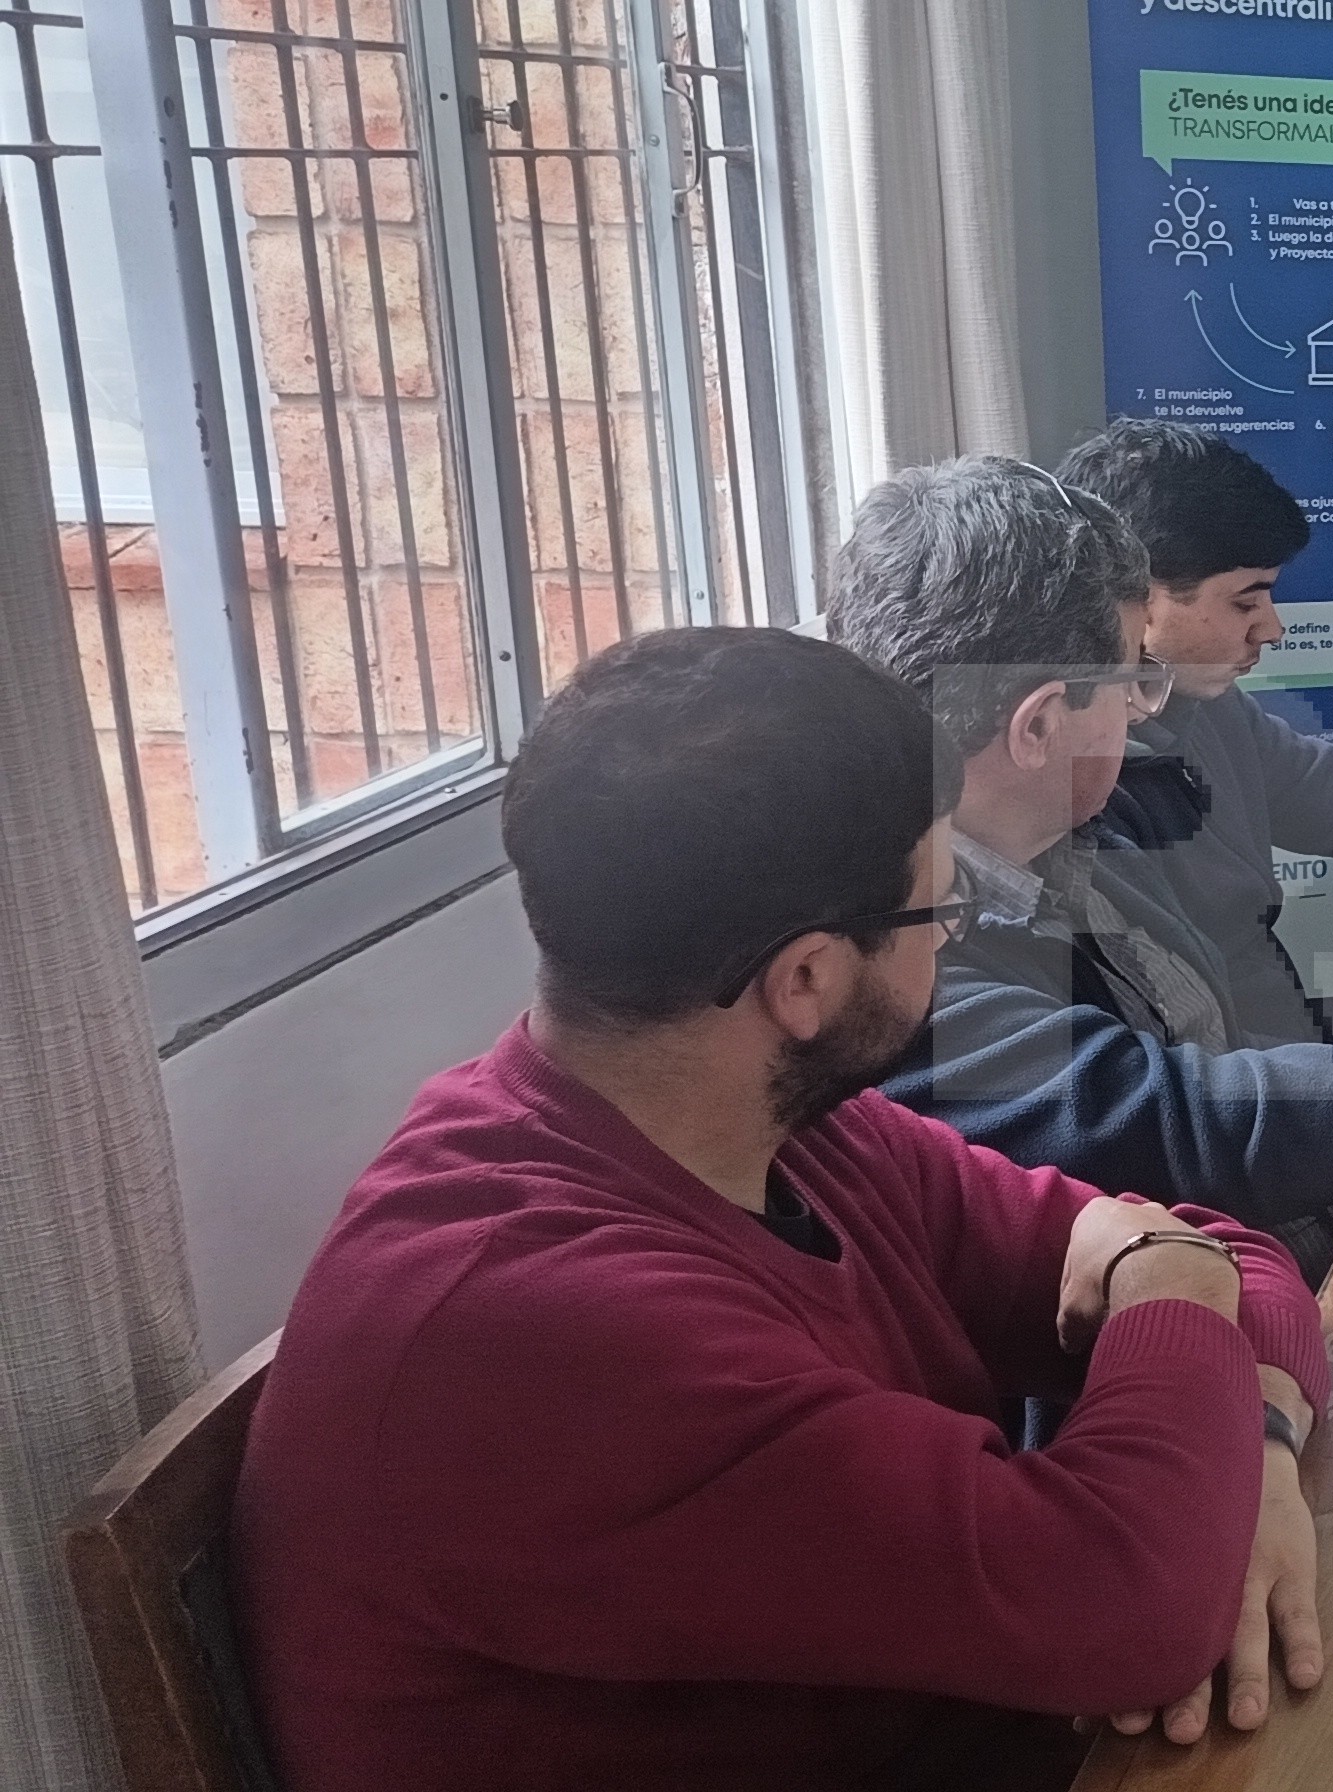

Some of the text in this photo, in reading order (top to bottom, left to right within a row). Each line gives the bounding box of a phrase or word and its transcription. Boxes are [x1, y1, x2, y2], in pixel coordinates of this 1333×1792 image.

[1140, 0, 1154, 14] y
[1168, 88, 1248, 112] ¿Tenés
[1254, 96, 1297, 113] una
[1250, 197, 1259, 209] 1.
[1293, 199, 1317, 210] Vas
[1319, 201, 1328, 210] a
[1250, 213, 1261, 225] 2.
[1268, 213, 1279, 225] El
[1250, 229, 1261, 241] 3.
[1268, 230, 1307, 244] Luego
[1309, 231, 1322, 242] la
[1269, 249, 1278, 260] y
[1136, 388, 1233, 402] 7. El municipio
[1154, 405, 1244, 416] te lo devuelve
[1219, 419, 1295, 434] sugerencias
[1315, 420, 1326, 430] 6.
[1289, 623, 1330, 634] define
[1285, 640, 1297, 650] lo
[1299, 641, 1317, 650] es,
[1320, 640, 1333, 648] te
